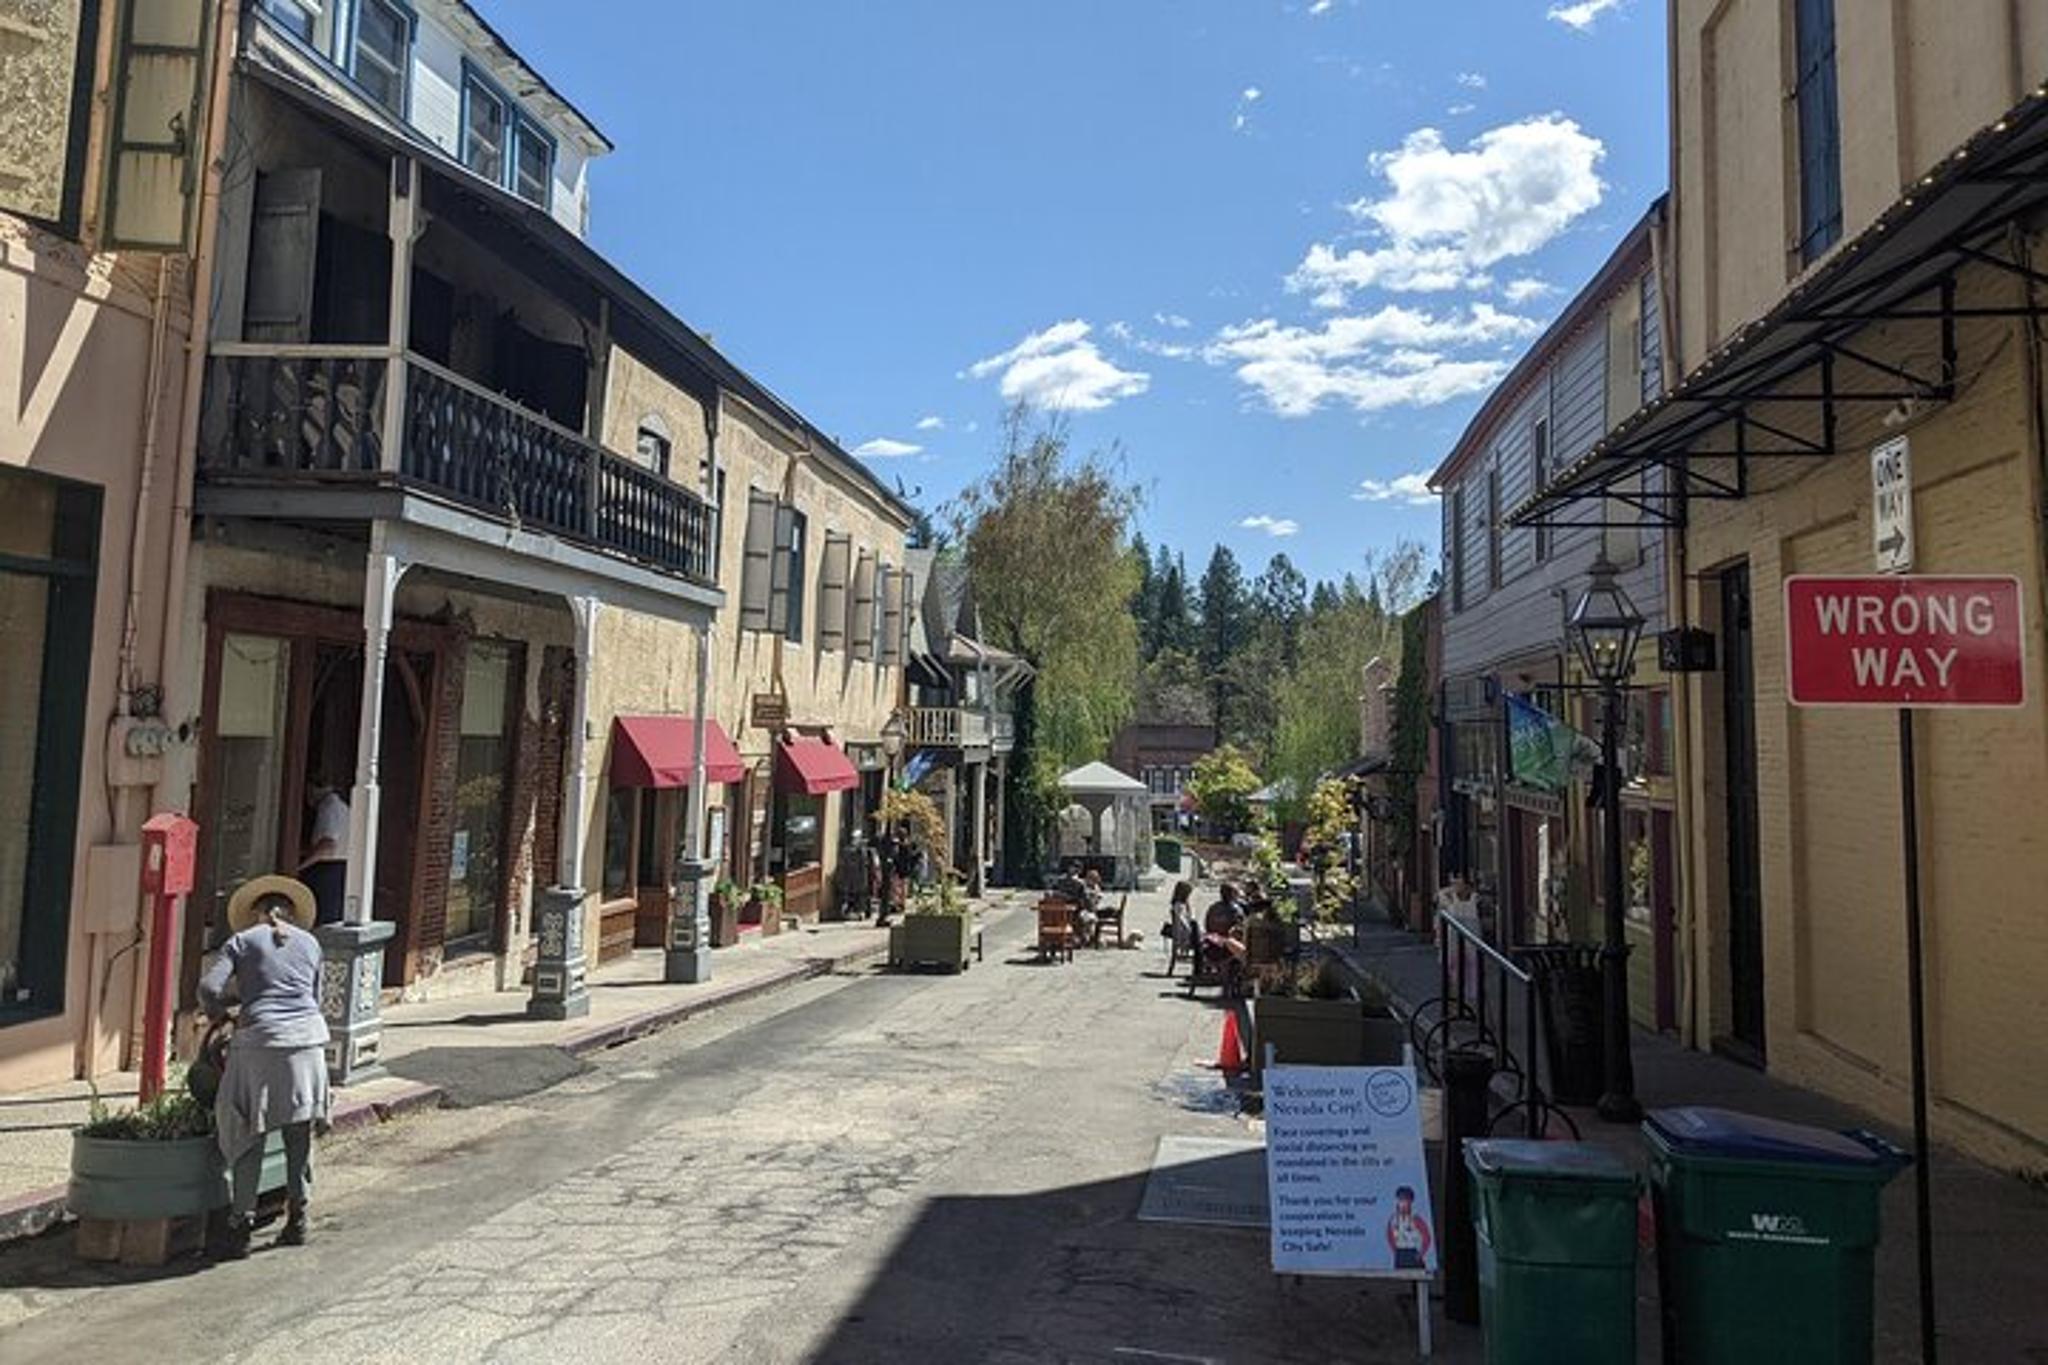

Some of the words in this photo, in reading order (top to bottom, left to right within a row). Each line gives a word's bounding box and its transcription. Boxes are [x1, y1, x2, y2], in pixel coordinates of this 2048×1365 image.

[1877, 449, 1904, 488] ONE
[1878, 491, 1905, 523] WAY
[1815, 595, 1994, 635] WRONG
[1852, 648, 1959, 687] WAY
[1271, 1084, 1336, 1098] Welcome
[1340, 1085, 1354, 1097] to
[1273, 1101, 1324, 1115] Nevada
[1327, 1100, 1363, 1119] City!
[1274, 1127, 1298, 1137] Face
[1300, 1127, 1349, 1138] coverings
[1353, 1126, 1371, 1136] and
[1275, 1141, 1303, 1152] social
[1305, 1141, 1357, 1153] distancing
[1362, 1143, 1378, 1152] are
[1275, 1157, 1327, 1167] mandated
[1342, 1157, 1358, 1166] the
[1276, 1173, 1289, 1183] all
[1279, 1195, 1310, 1206] Thank
[1314, 1197, 1332, 1207] you
[1335, 1195, 1351, 1205] for
[1353, 1196, 1377, 1207] your
[1279, 1212, 1343, 1222] cooperation
[1280, 1227, 1322, 1238] keeping
[1325, 1226, 1366, 1237] Nevada
[1282, 1241, 1303, 1252] City
